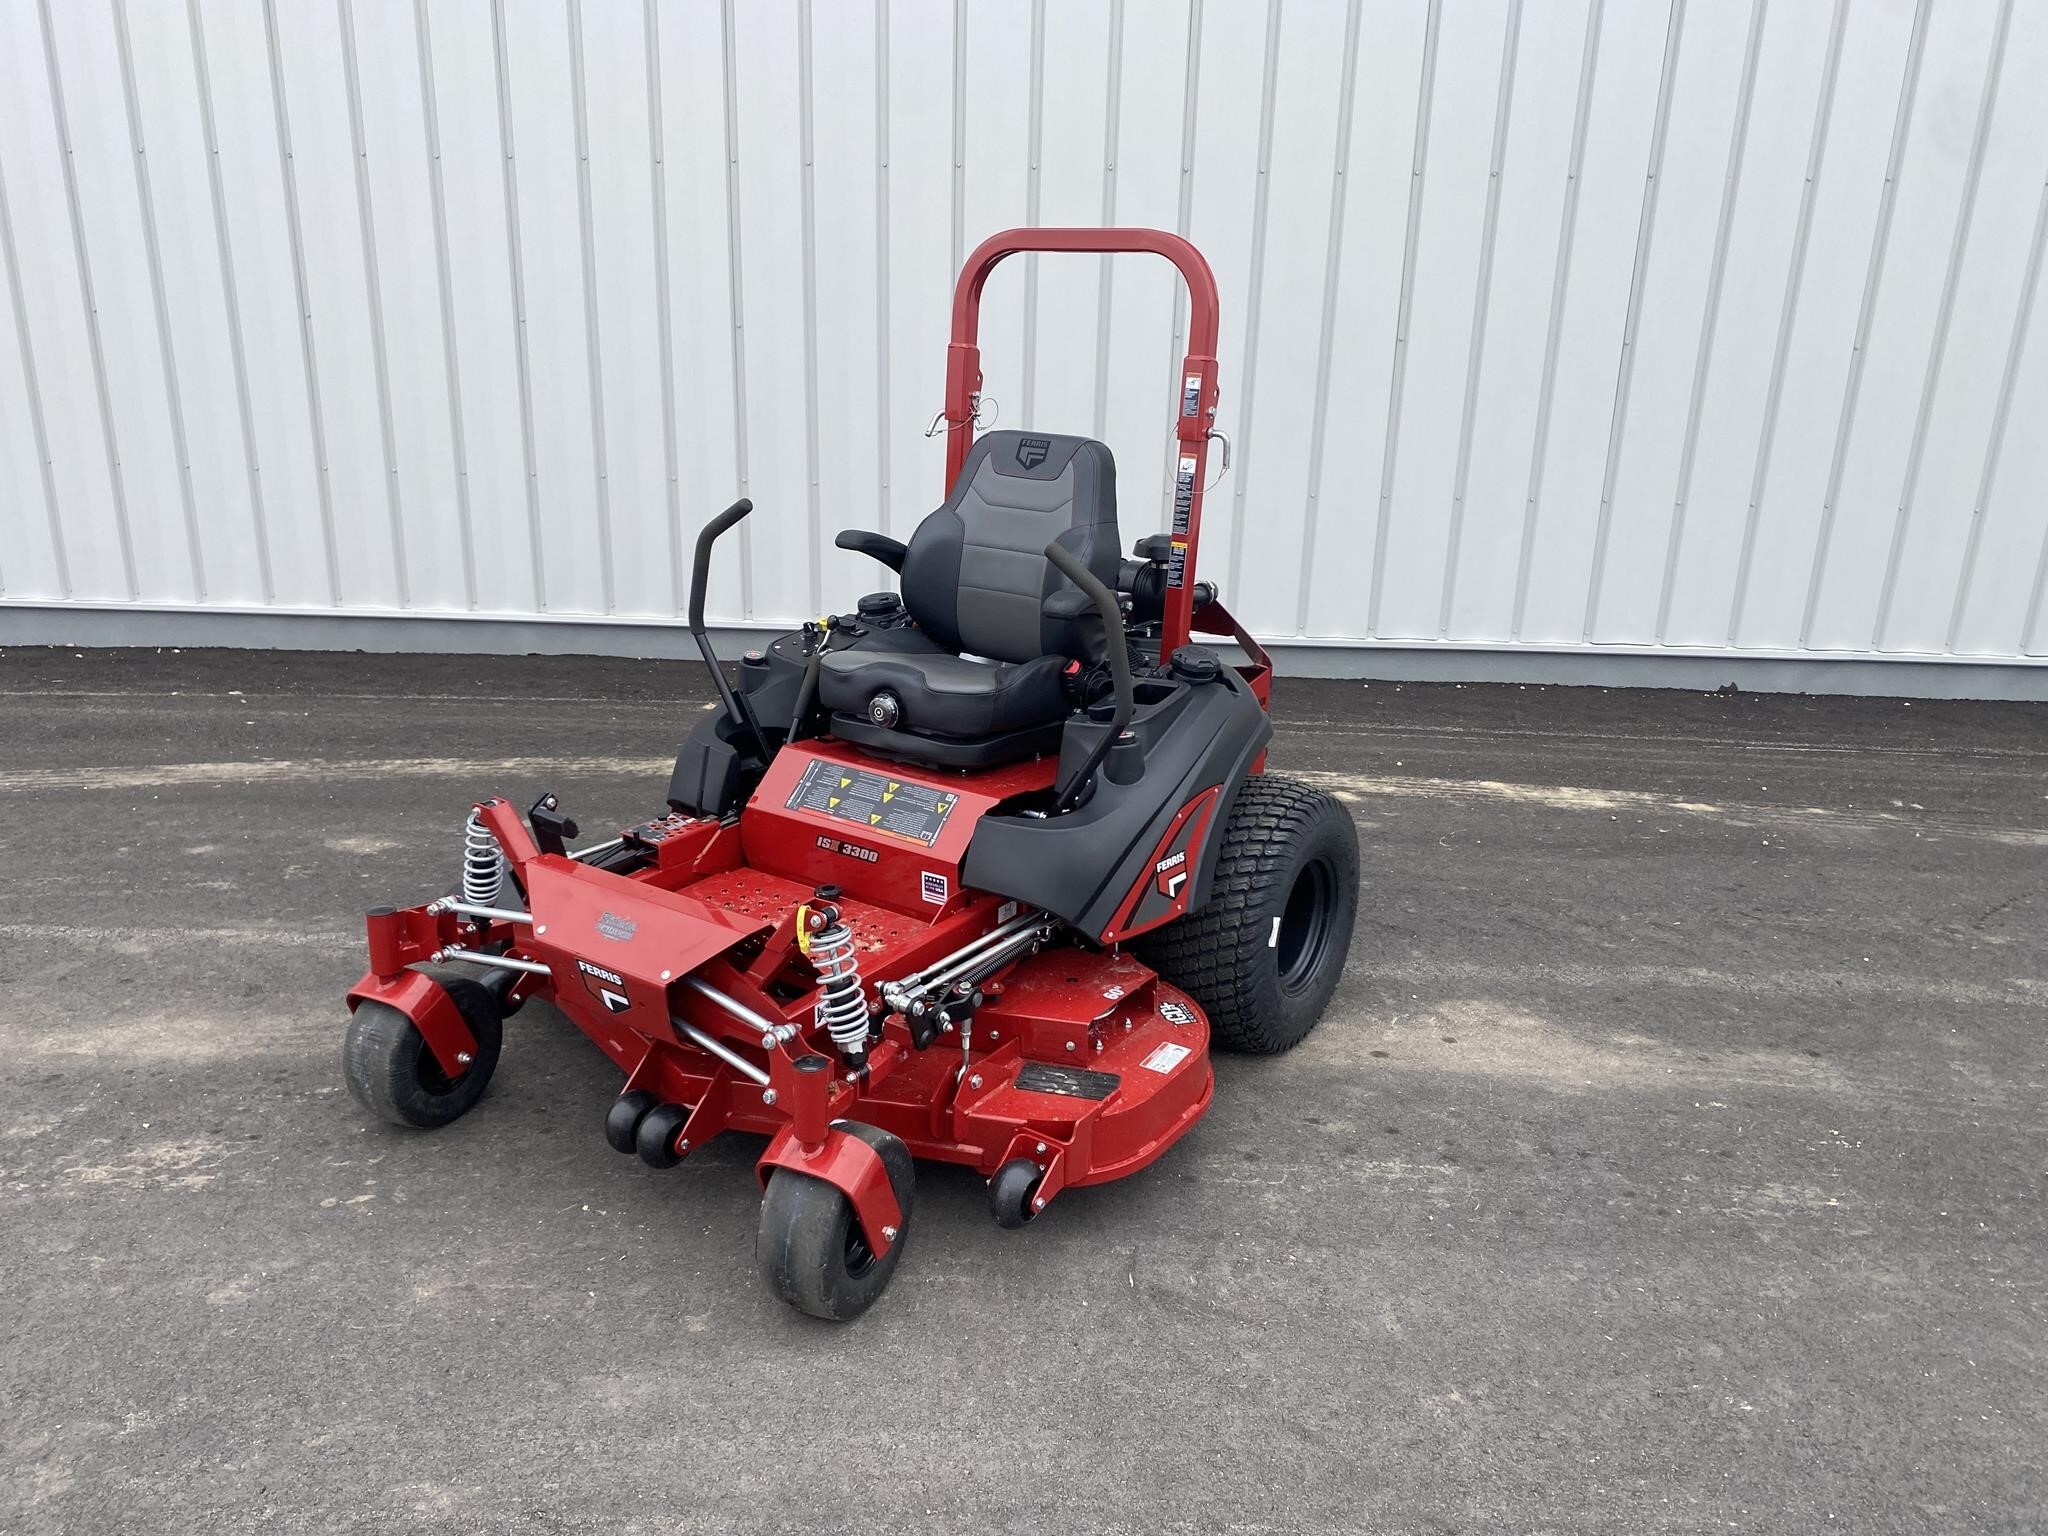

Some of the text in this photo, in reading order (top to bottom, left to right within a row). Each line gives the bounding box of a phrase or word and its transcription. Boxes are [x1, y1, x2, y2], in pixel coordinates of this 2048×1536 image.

[1022, 440, 1049, 448] FERRIS
[816, 836, 879, 862] ISX 3300
[1156, 851, 1186, 873] FERRIS
[578, 960, 622, 985] FERRIS
